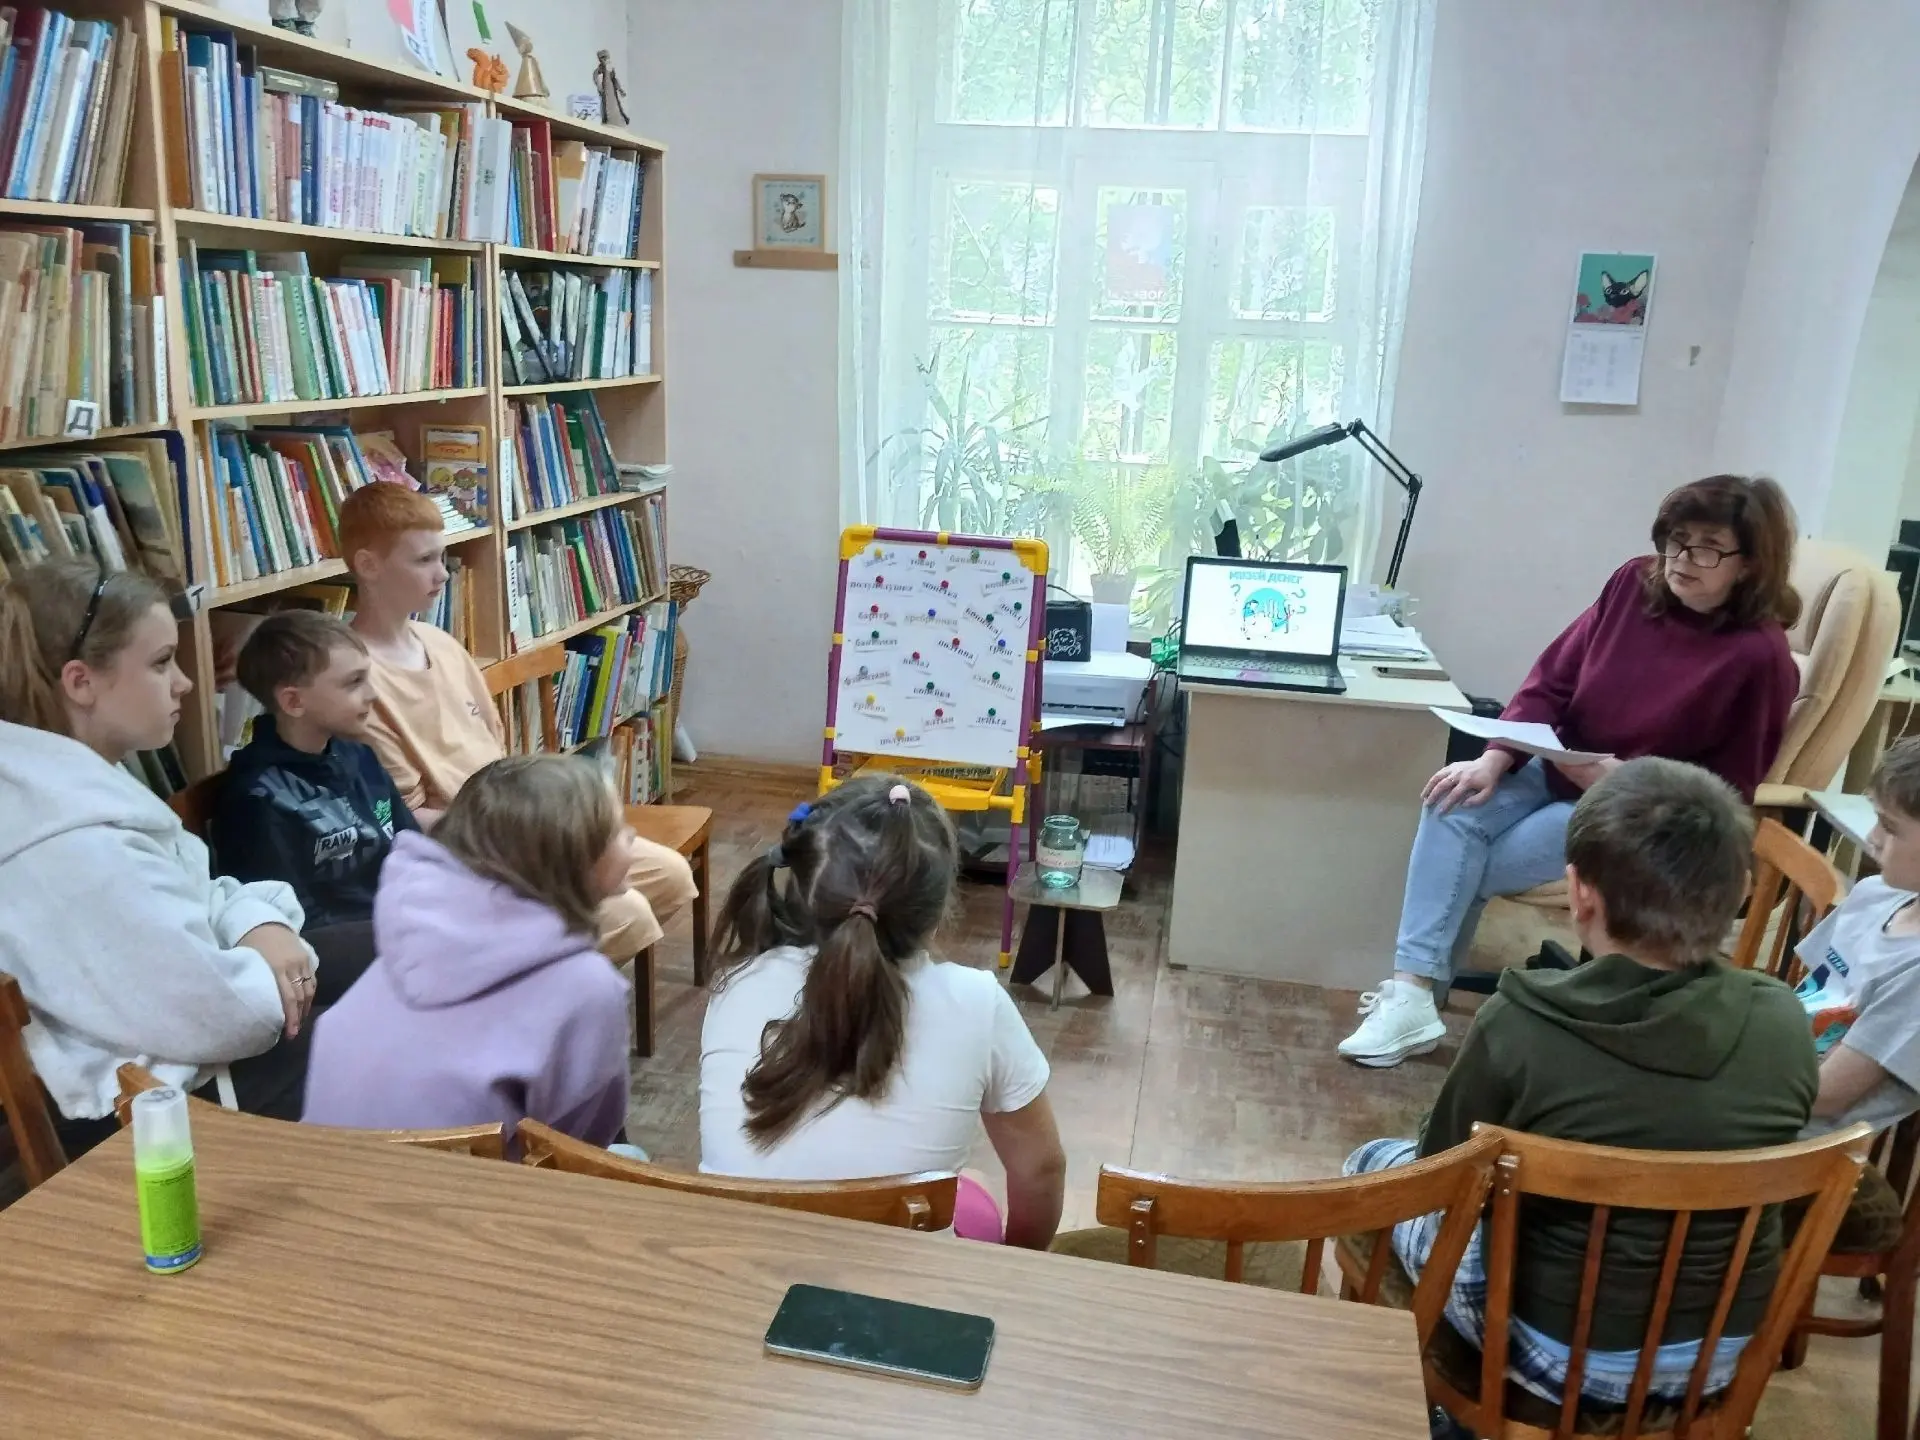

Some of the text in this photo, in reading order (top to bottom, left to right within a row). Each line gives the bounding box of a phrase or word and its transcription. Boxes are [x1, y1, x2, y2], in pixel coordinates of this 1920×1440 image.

[67, 406, 93, 435] Д
[910, 559, 936, 569] товар
[857, 611, 890, 621] бартер
